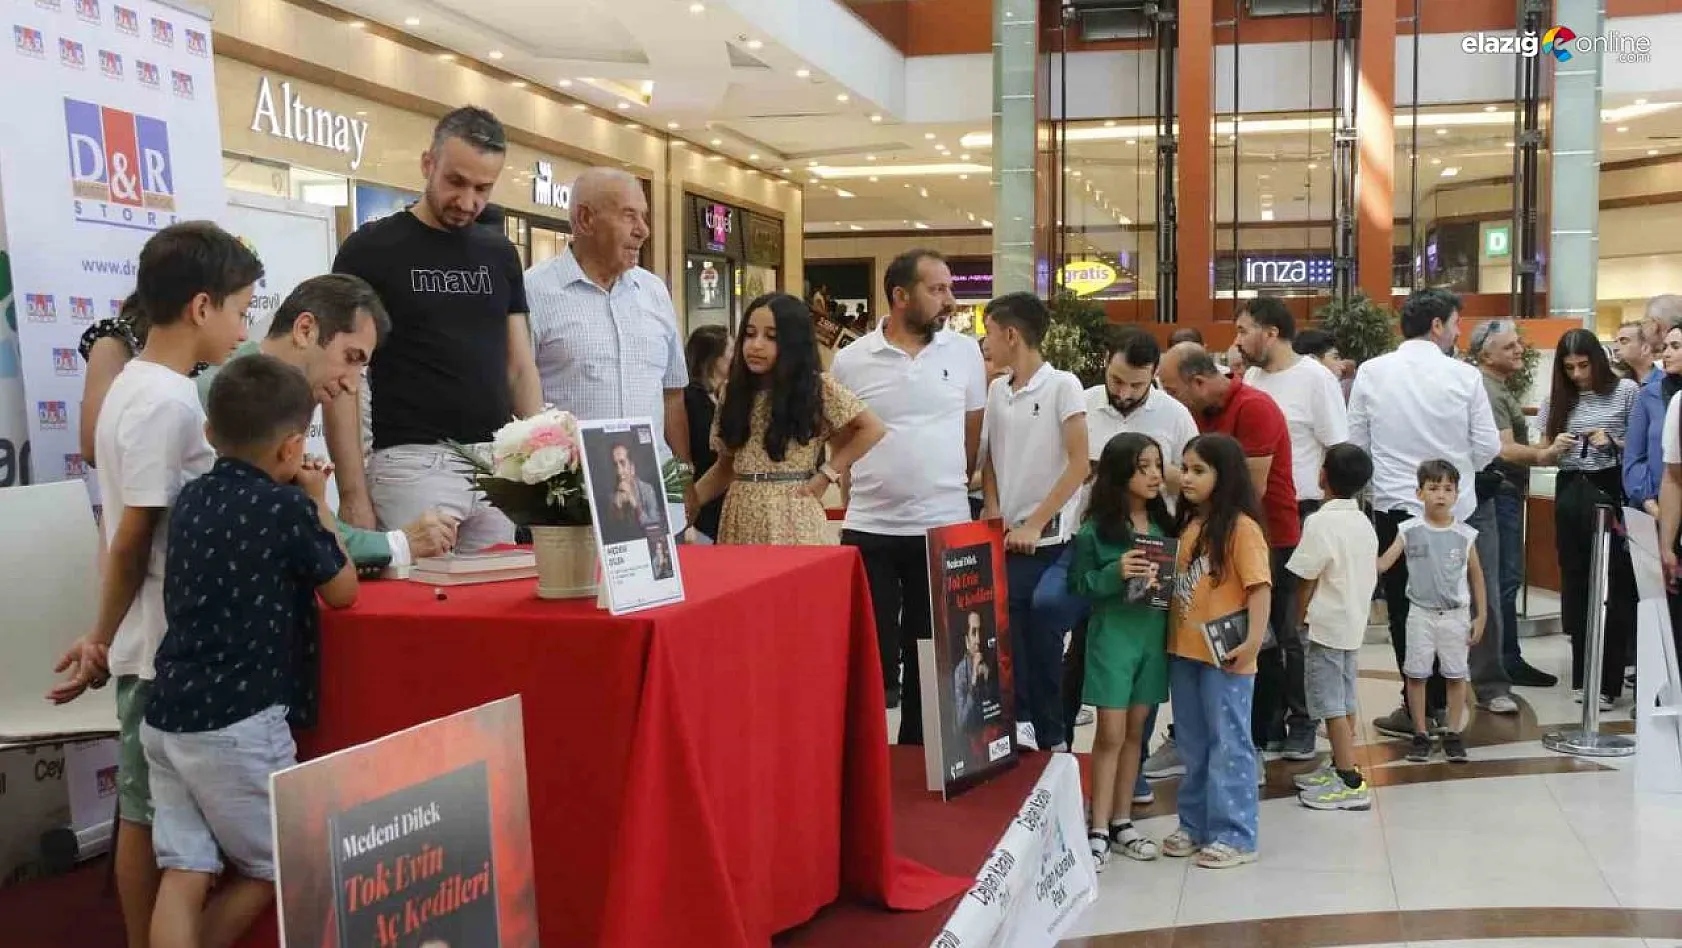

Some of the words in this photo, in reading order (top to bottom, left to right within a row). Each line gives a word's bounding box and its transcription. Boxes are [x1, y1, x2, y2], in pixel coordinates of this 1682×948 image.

[251, 76, 368, 170] Altınay
[70, 133, 170, 201] D&R
[411, 265, 494, 294] mavi
[1063, 266, 1109, 285] gratis
[1246, 258, 1306, 283] imza
[342, 815, 399, 861] Medeni
[402, 801, 441, 837] Dilek
[345, 859, 391, 914] Tok
[396, 843, 444, 892] Evin
[404, 861, 490, 934] Kedileri
